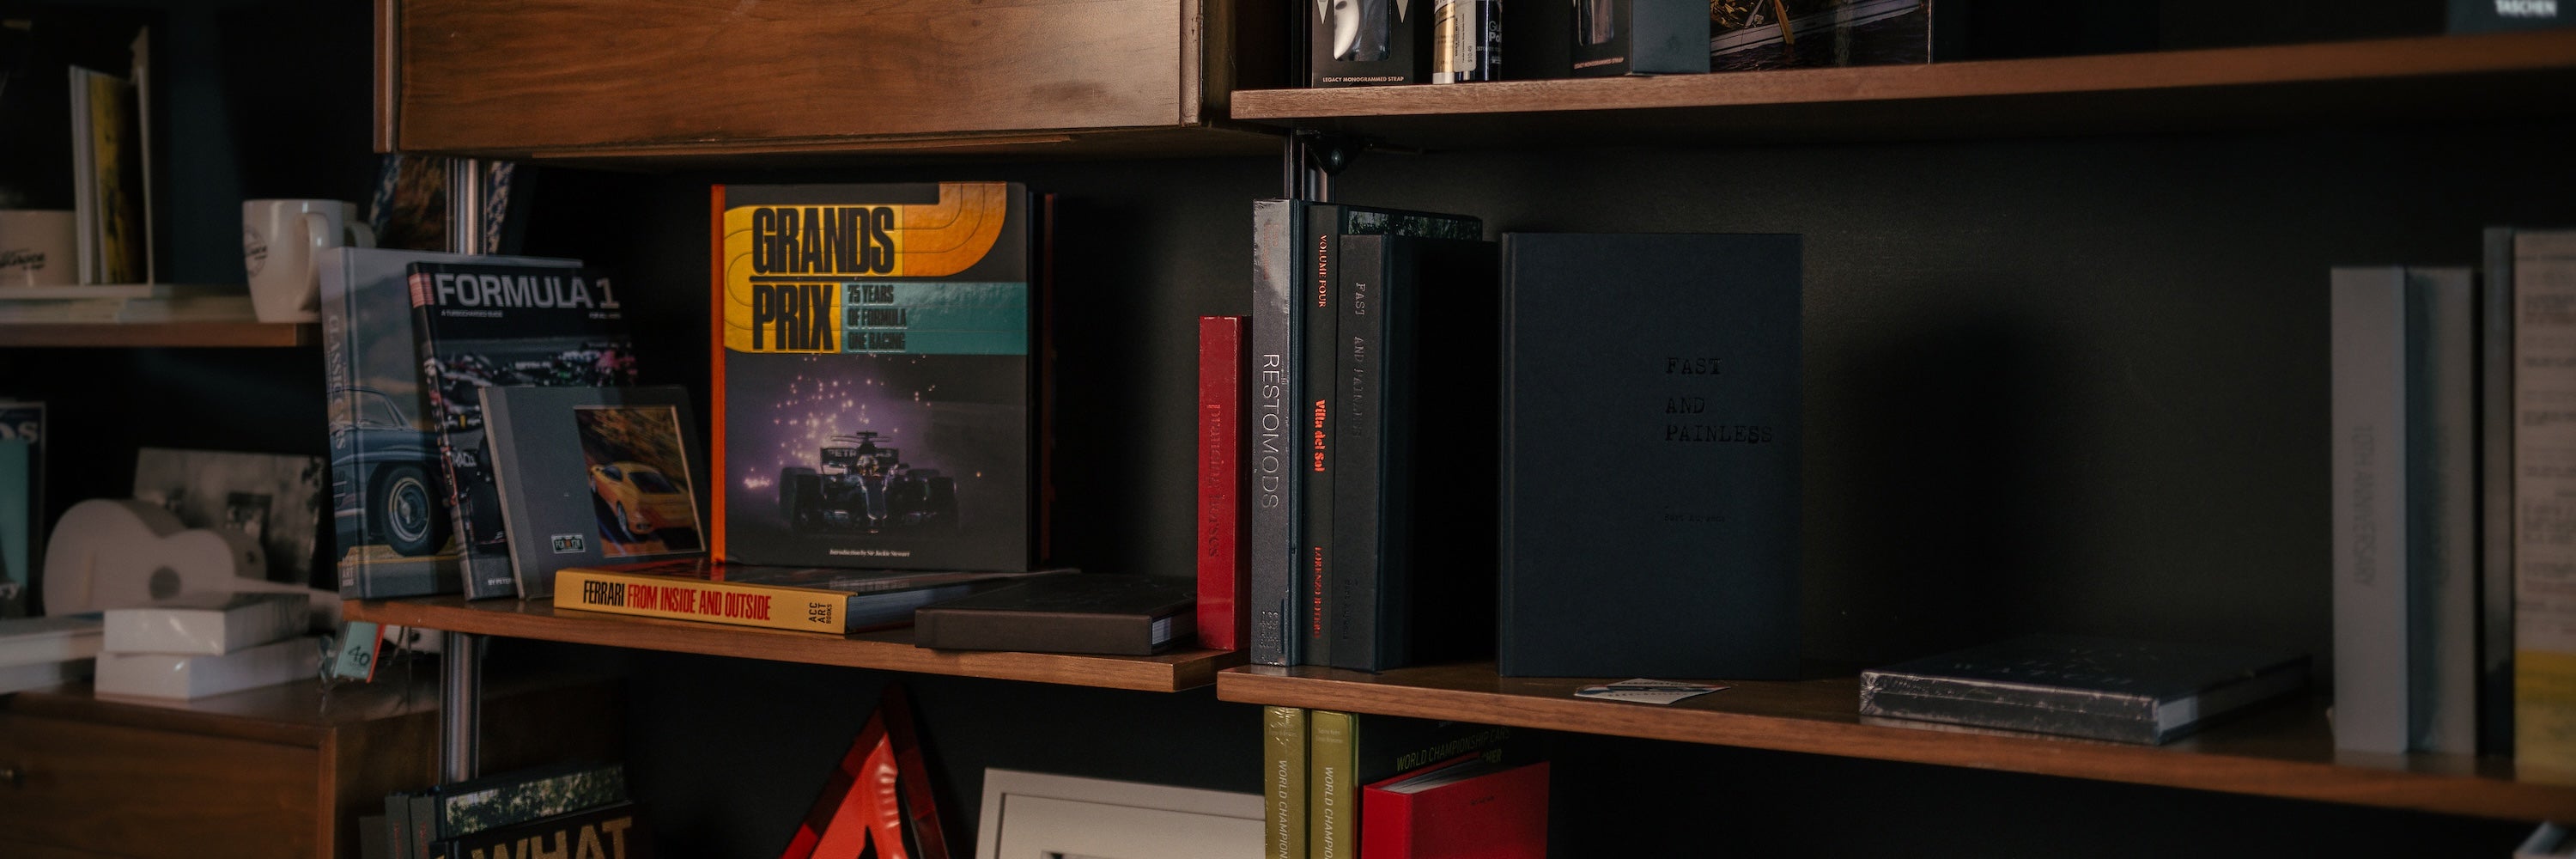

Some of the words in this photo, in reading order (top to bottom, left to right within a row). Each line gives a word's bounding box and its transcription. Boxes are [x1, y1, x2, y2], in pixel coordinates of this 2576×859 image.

[2494, 0, 2558, 17] TASCHEN
[753, 207, 895, 275] GRANDS
[1318, 235, 1328, 278] VOLUME
[434, 272, 595, 309] FORMULA
[595, 277, 621, 309] 1
[848, 284, 860, 303] 75
[862, 284, 894, 303] YEARS
[1318, 279, 1327, 308] FOUR
[1355, 282, 1366, 317] FAST
[753, 285, 834, 350] PRIX
[848, 308, 860, 327] OF
[861, 308, 907, 327] FORMULA
[329, 315, 343, 393] CLASSIC
[848, 332, 867, 350] ONE
[868, 332, 906, 350] RACING
[1353, 336, 1364, 362] AND
[1666, 356, 1722, 375] FAST
[332, 397, 347, 450] CARS
[1314, 399, 1327, 429] Villa
[1665, 397, 1705, 414] AND
[1206, 404, 1224, 488] prancing
[1262, 354, 1280, 508] RESTOMODS
[1314, 430, 1327, 450] del
[1665, 424, 1773, 444] PAINLESS
[1313, 451, 1327, 472] Sol
[1208, 494, 1225, 557] horses
[1313, 545, 1323, 595] LORENZO
[583, 579, 625, 607] FERRARI
[627, 583, 657, 610] FROM
[659, 587, 697, 614] INSIDE
[699, 591, 722, 616] AND
[725, 593, 772, 621] OUTSIDE
[817, 602, 826, 624] ART
[348, 646, 371, 667] 40
[1396, 748, 1427, 771] WORLD
[1428, 730, 1489, 762] CHAMPIONSHIP
[1490, 726, 1511, 743] CARS
[1278, 760, 1287, 799] WORLD
[1324, 766, 1334, 806] WORLD
[1279, 801, 1288, 859] CHAMPION
